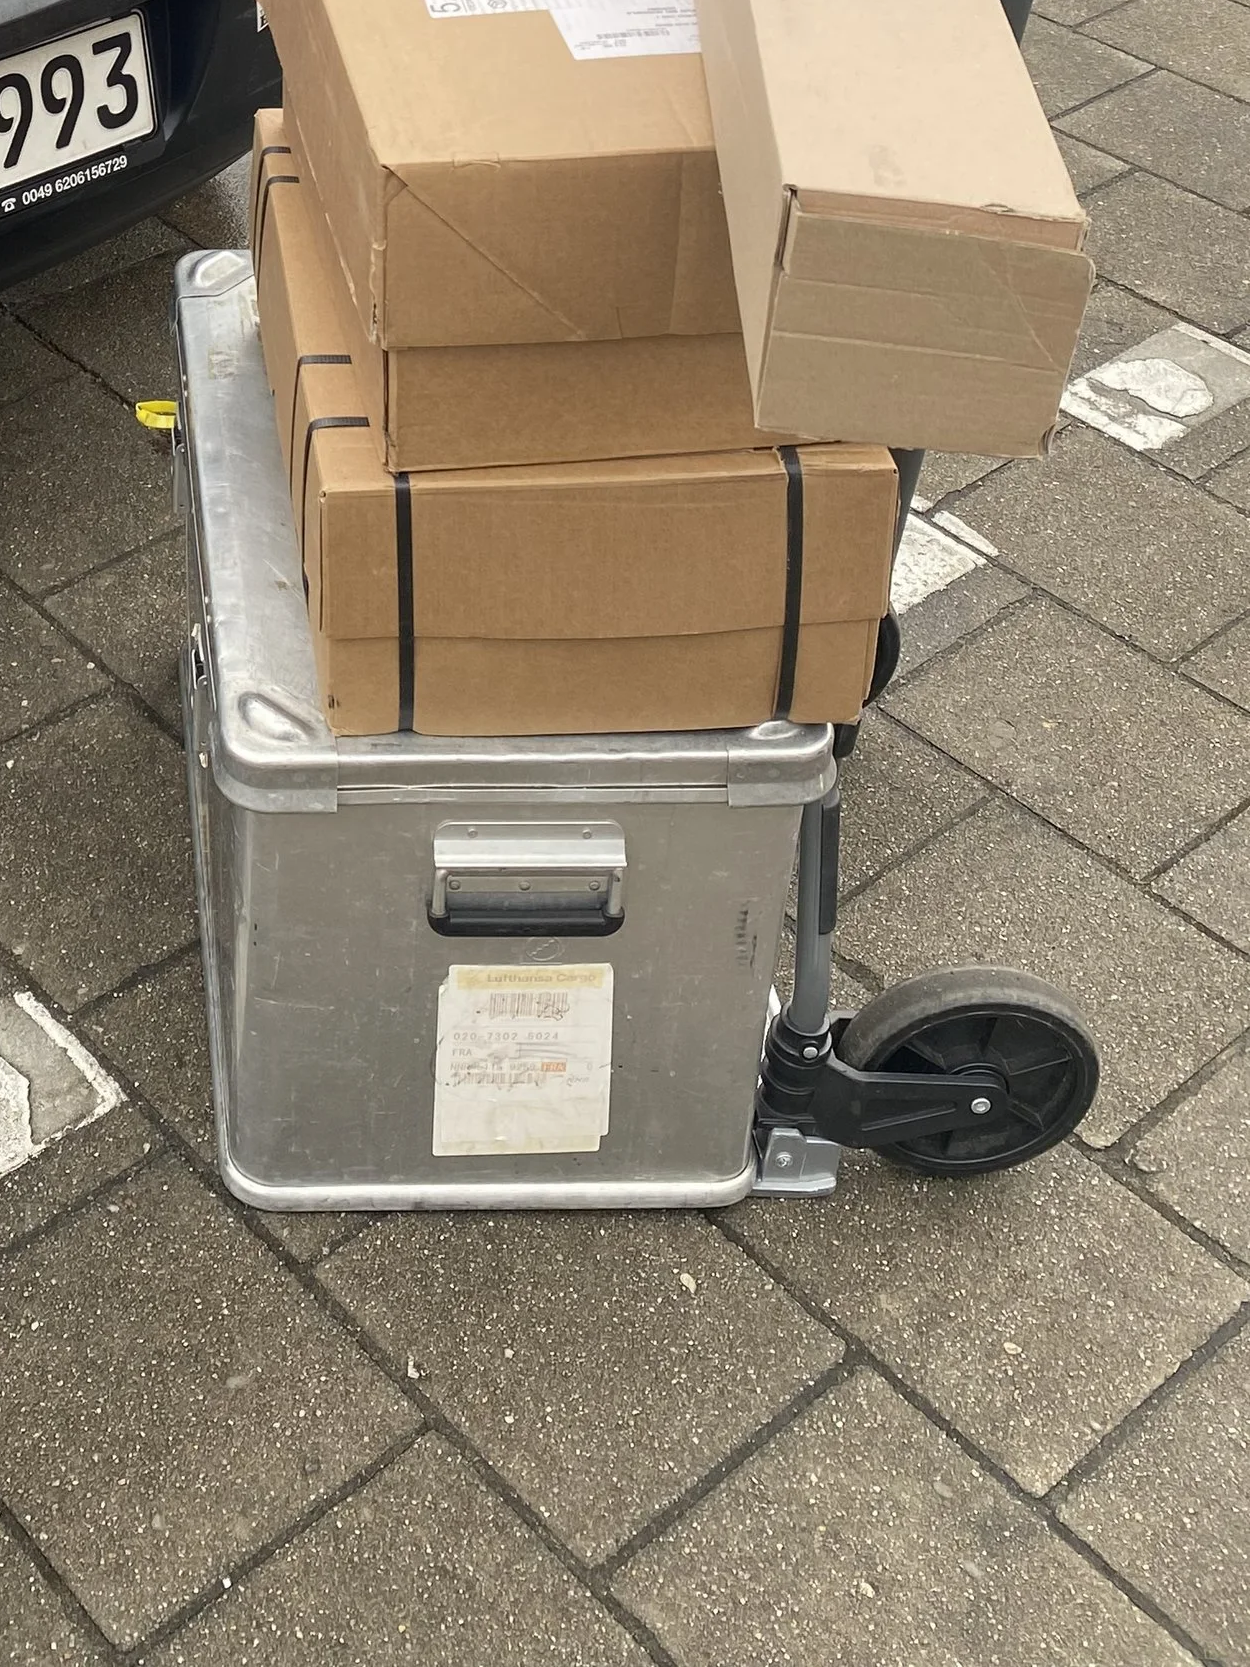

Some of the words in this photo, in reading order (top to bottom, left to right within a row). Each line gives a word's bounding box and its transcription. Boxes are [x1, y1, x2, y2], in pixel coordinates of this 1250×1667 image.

[21, 183, 53, 206] 0049
[54, 154, 128, 194] 6206156729
[487, 973, 553, 983] Lufthansa
[556, 973, 596, 985] Cargo
[452, 1048, 472, 1056] FRA
